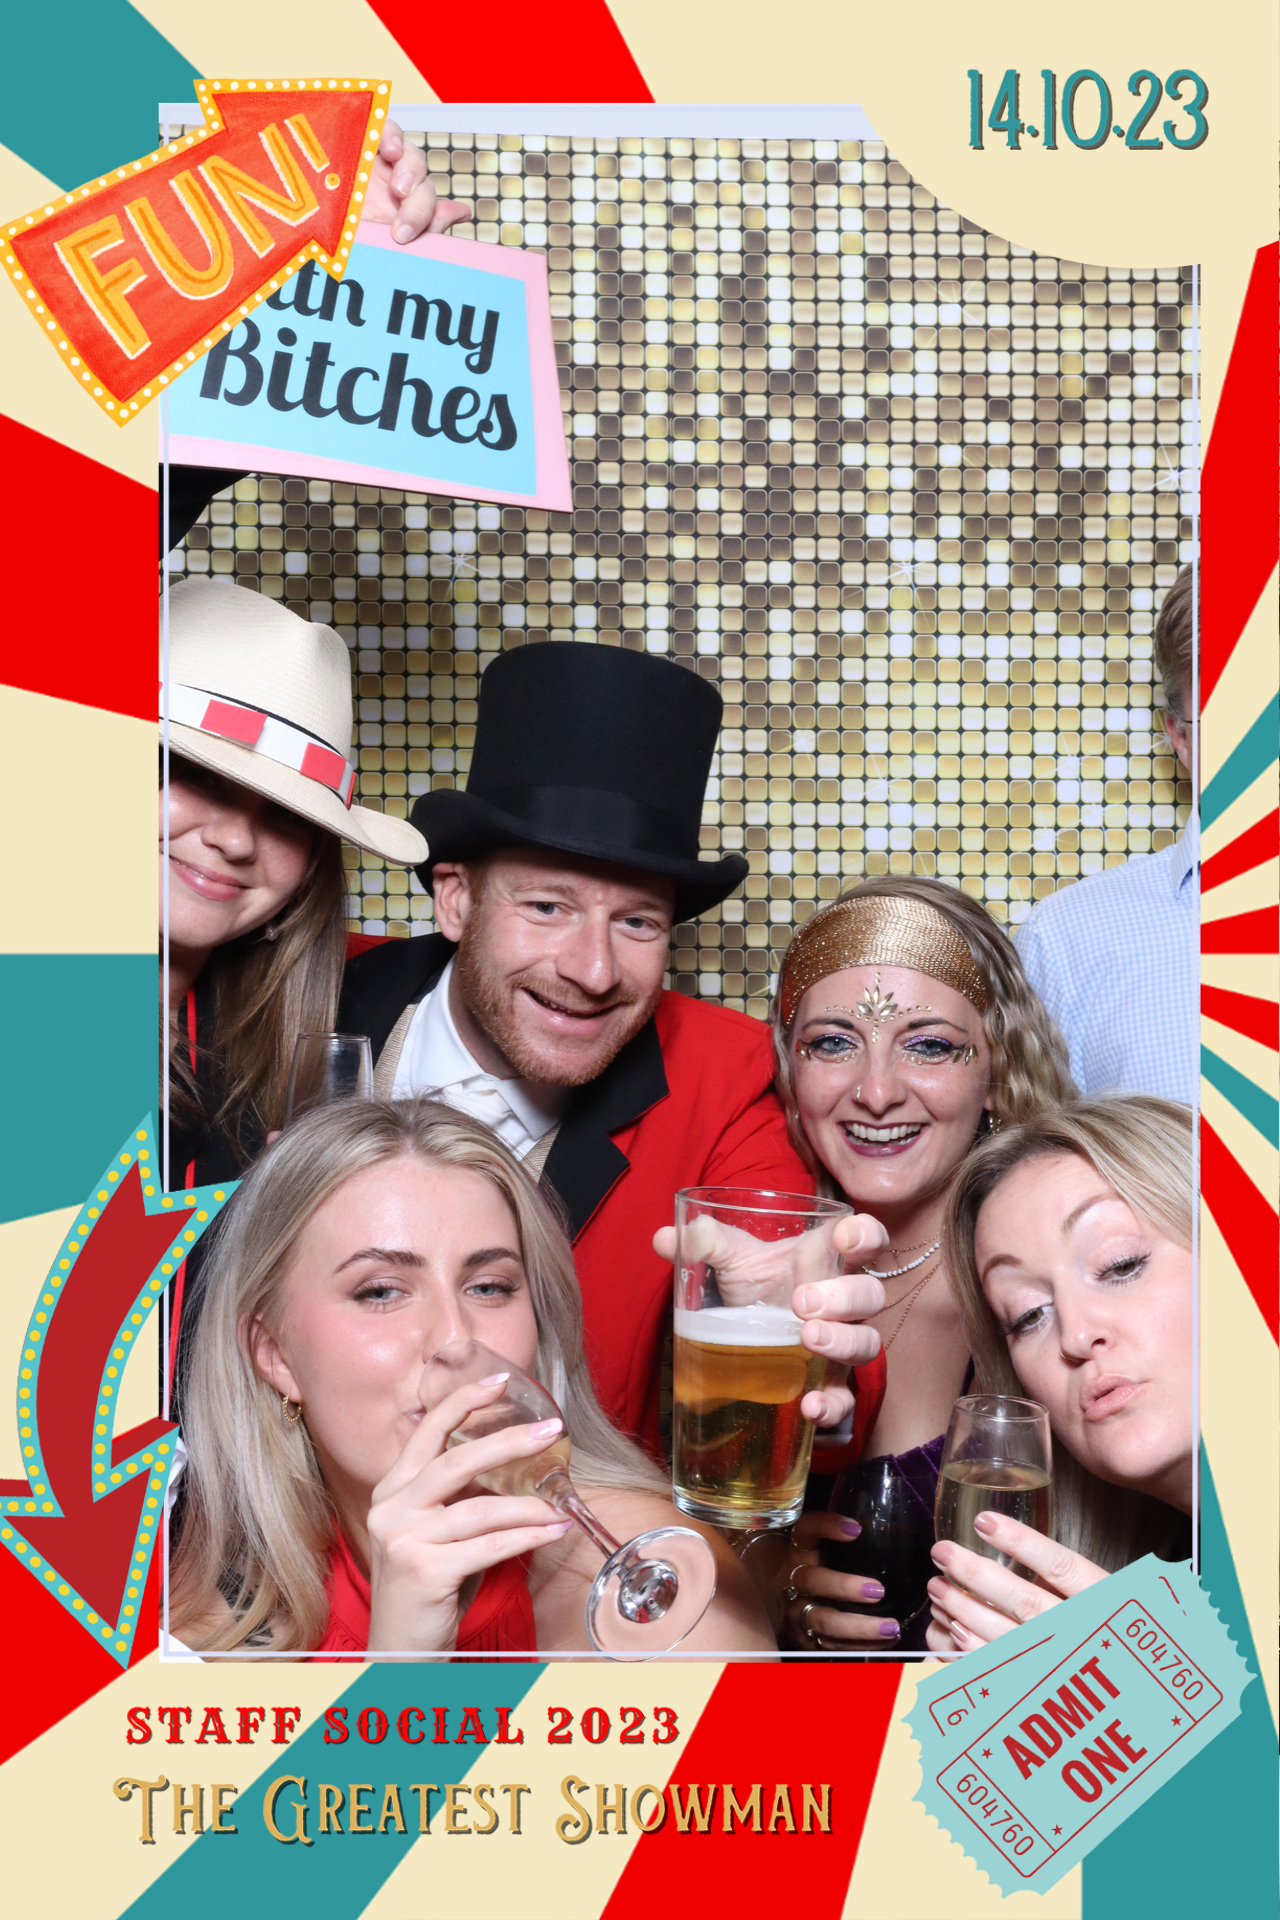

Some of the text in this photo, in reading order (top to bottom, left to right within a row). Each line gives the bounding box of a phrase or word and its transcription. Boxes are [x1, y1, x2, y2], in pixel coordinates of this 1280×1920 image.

[265, 258, 499, 375] th my
[199, 317, 518, 451] Bitches
